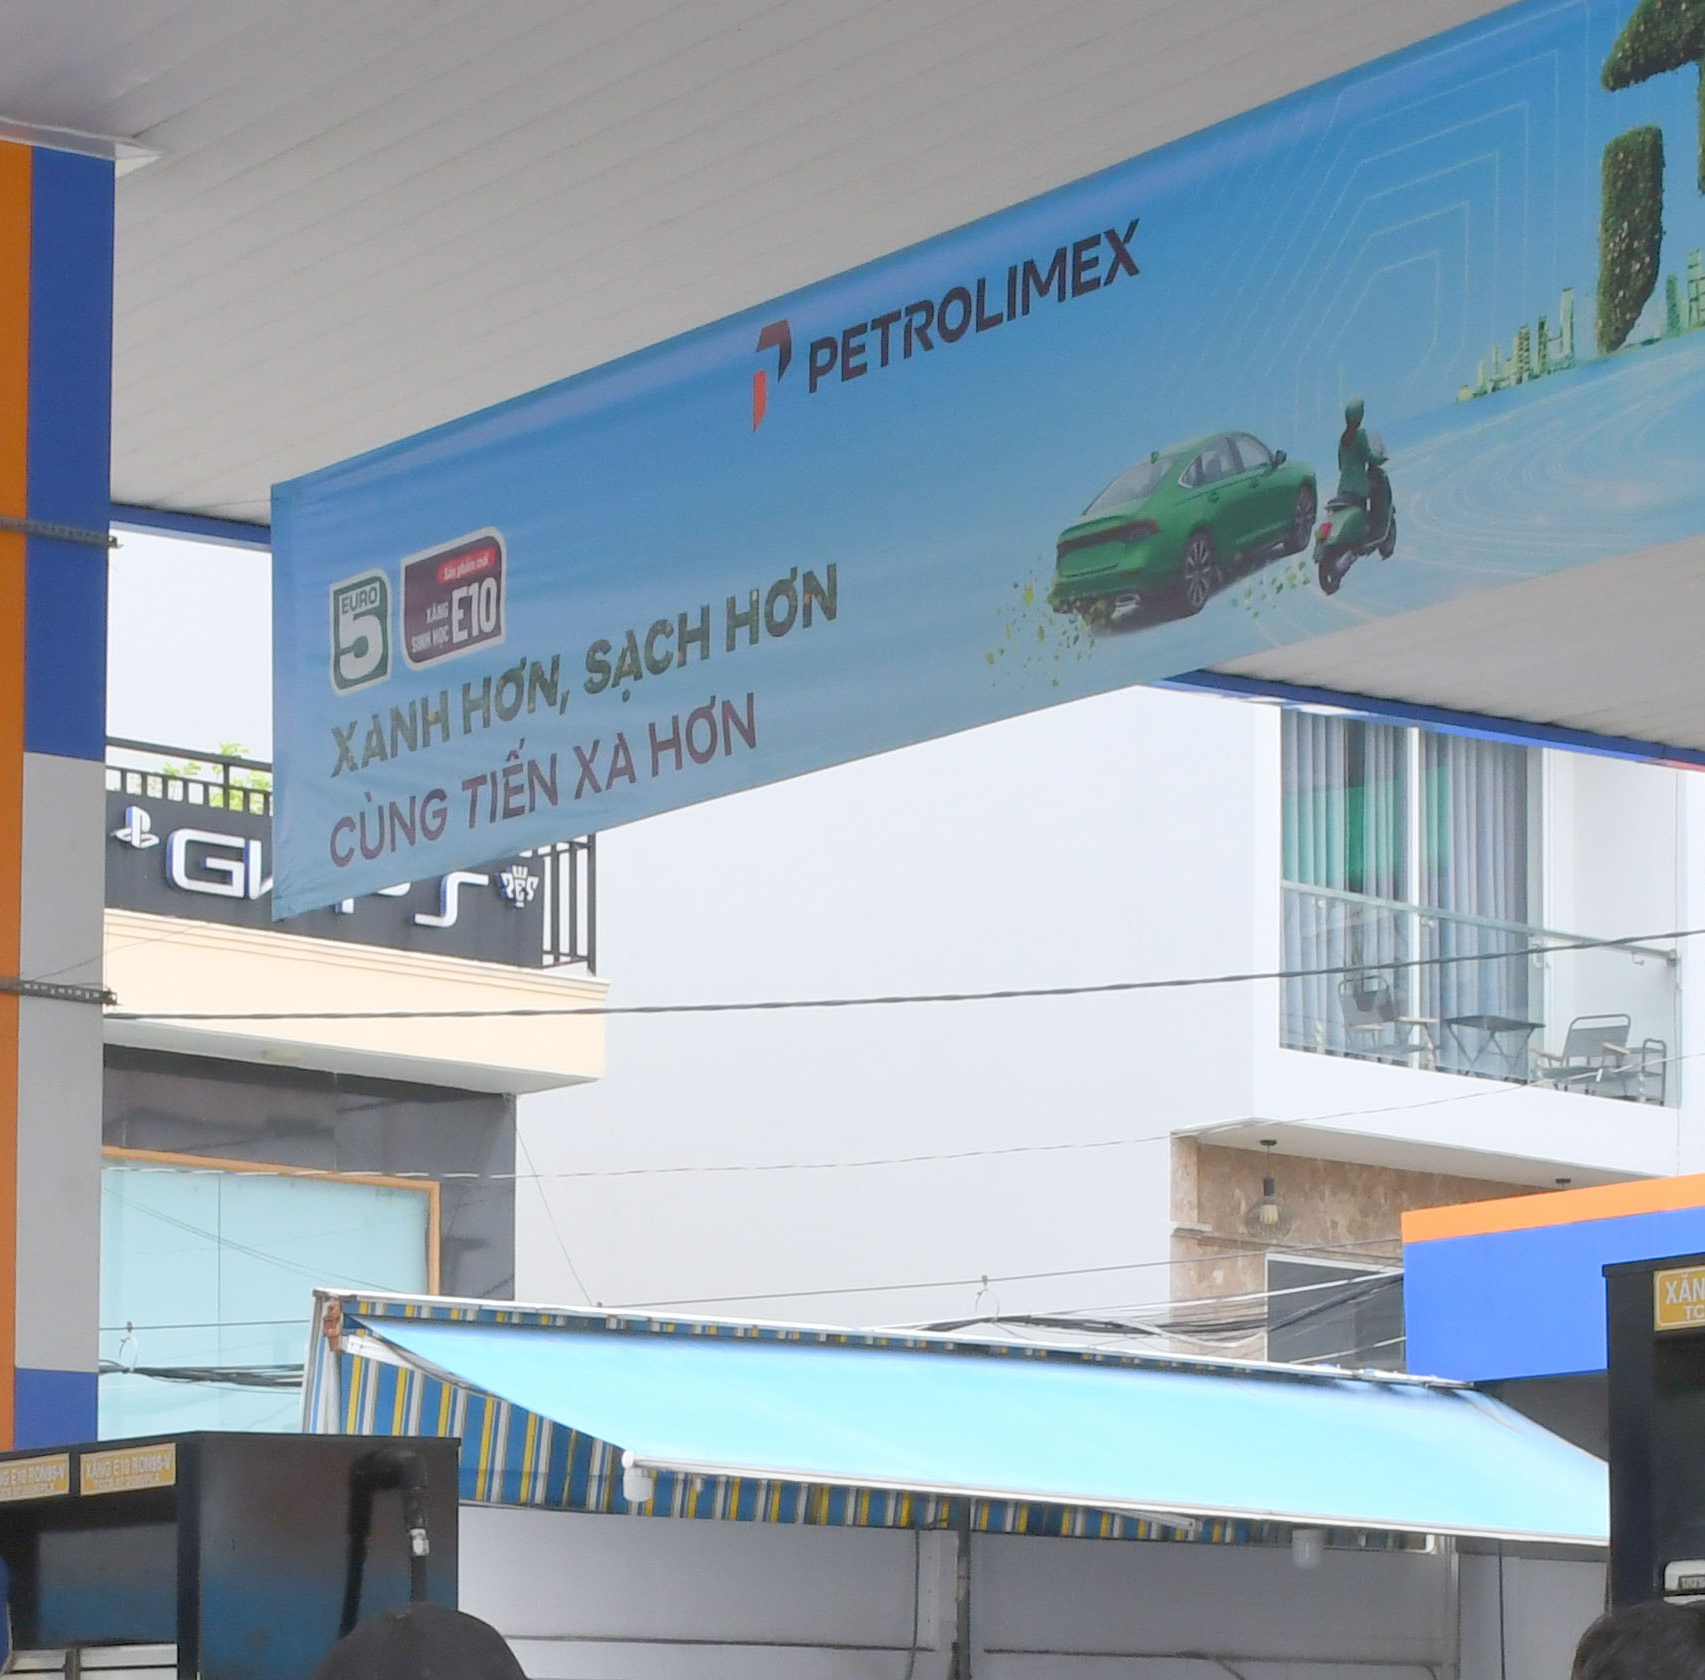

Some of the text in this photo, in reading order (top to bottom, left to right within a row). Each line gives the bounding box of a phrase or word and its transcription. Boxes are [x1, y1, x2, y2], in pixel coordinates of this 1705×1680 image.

[809, 218, 1140, 394] PETROLIMEX
[339, 613, 383, 680] 5
[341, 586, 379, 615] EURO
[452, 577, 497, 643] E10
[331, 563, 837, 777] XANH HƠN, SẠCH HƠN
[330, 692, 757, 867] CÙNG TIẾN XA HƠN
